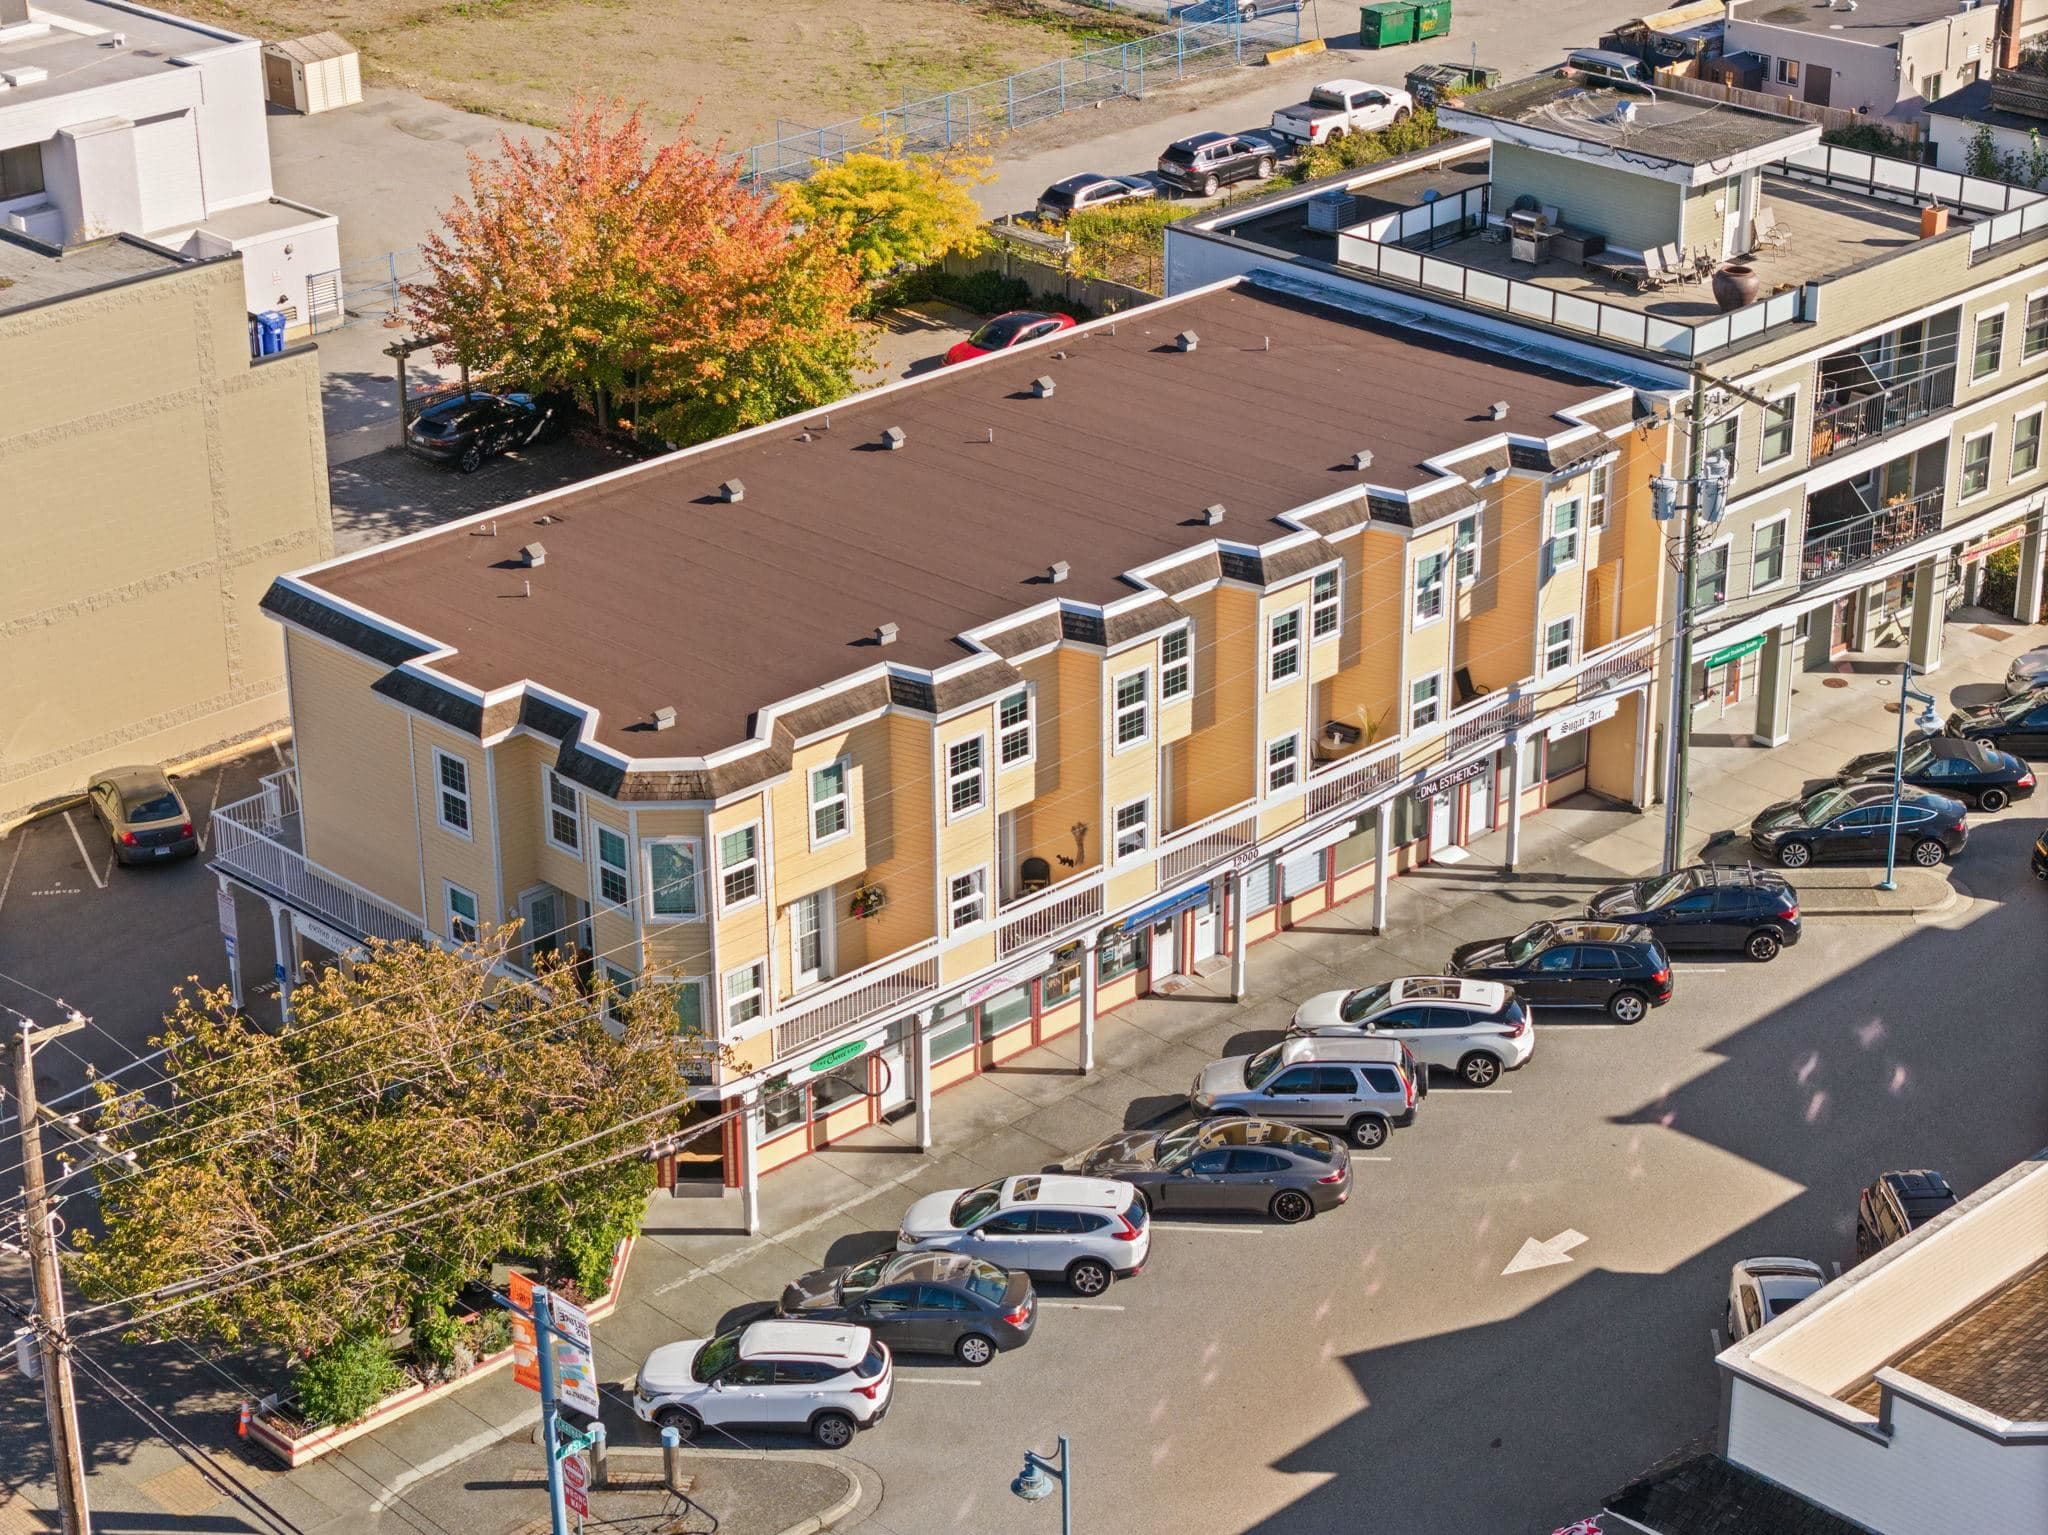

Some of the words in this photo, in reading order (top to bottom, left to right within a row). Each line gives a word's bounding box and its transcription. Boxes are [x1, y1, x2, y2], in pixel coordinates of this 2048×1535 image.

[1560, 717, 1586, 735] Sugar
[1588, 710, 1602, 722] Art
[1420, 782, 1439, 798] DNA
[1440, 762, 1480, 789] ESTHETICS
[31, 888, 81, 896] RESERVED
[565, 1487, 588, 1506] WRONG
[570, 1498, 583, 1513] WAY
